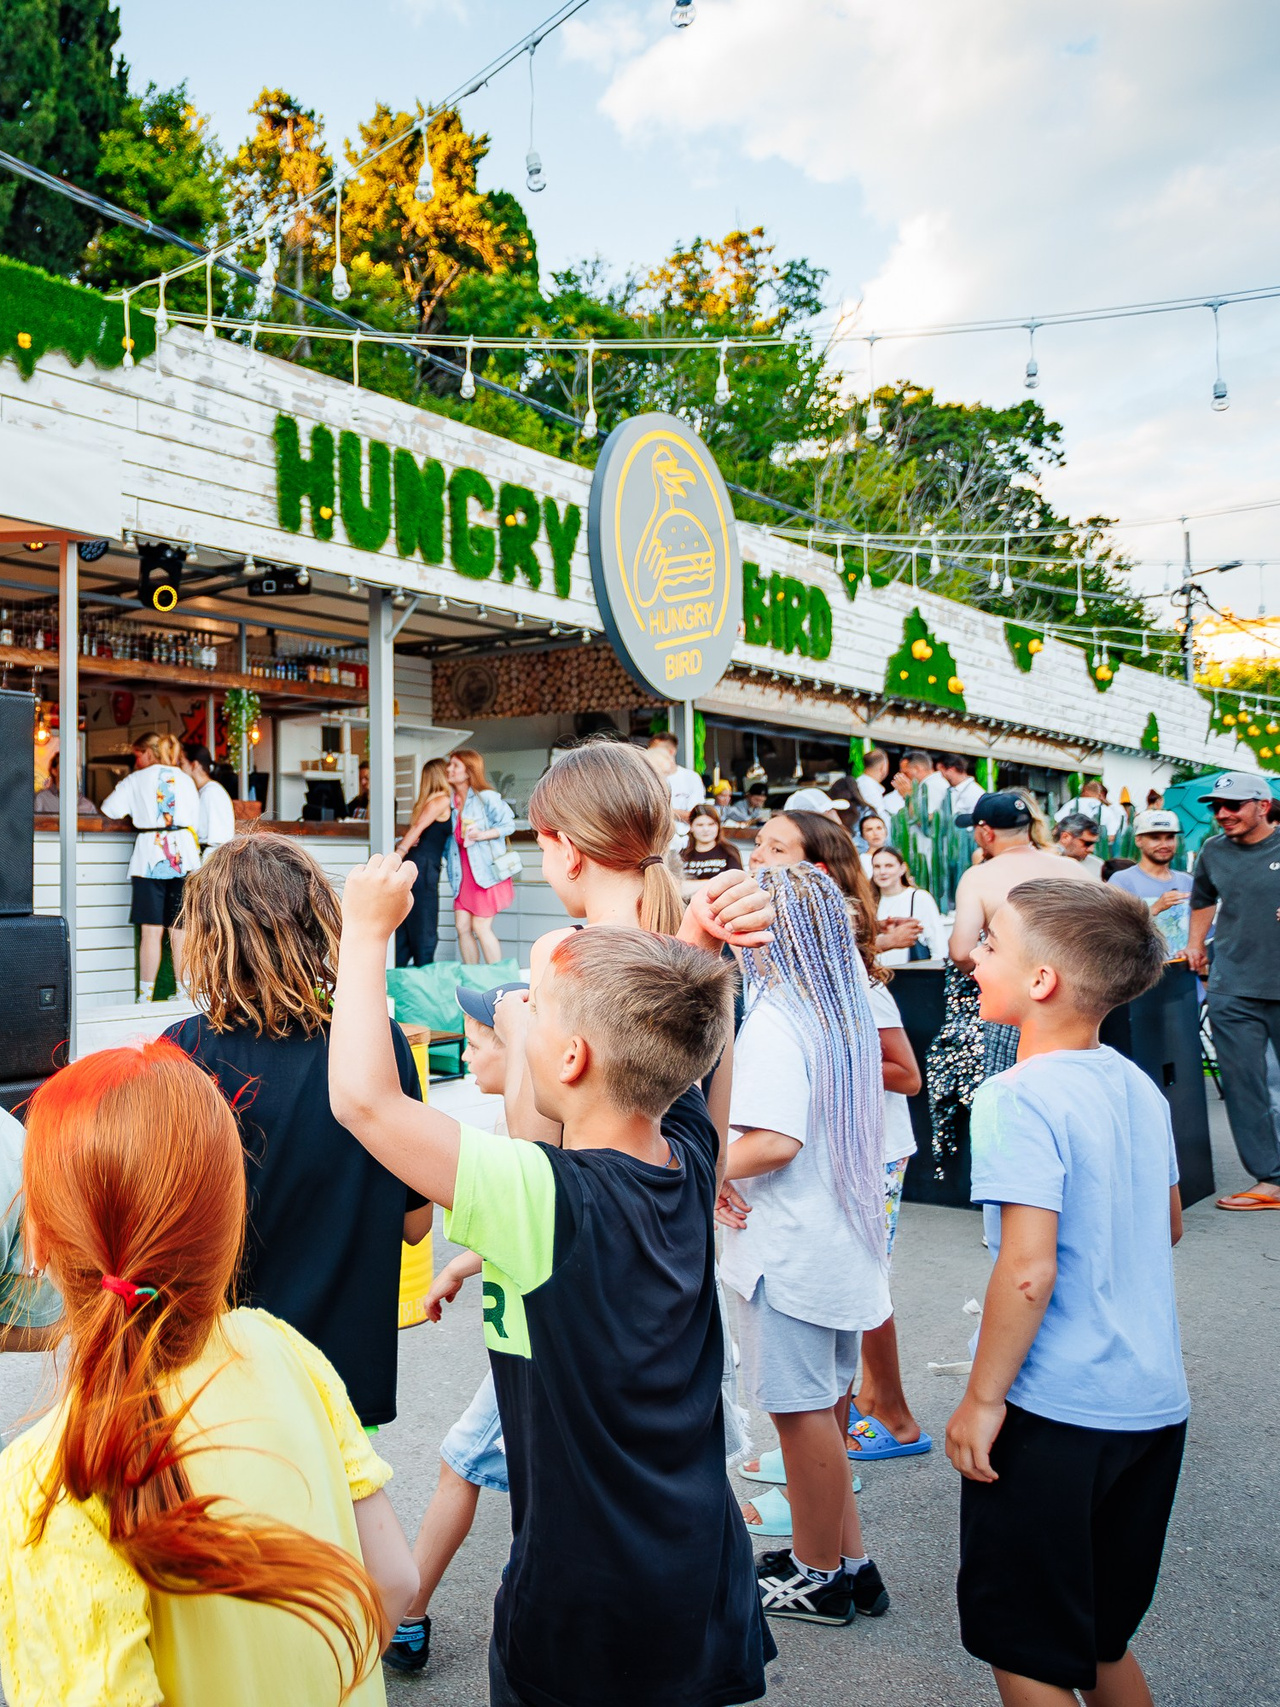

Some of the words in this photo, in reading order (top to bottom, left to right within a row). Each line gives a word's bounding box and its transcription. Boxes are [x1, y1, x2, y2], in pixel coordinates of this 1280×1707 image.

[273, 412, 582, 601] HUNGRY
[742, 559, 833, 661] BIRD
[649, 601, 715, 636] HUNGRY
[665, 648, 703, 681] BIRD
